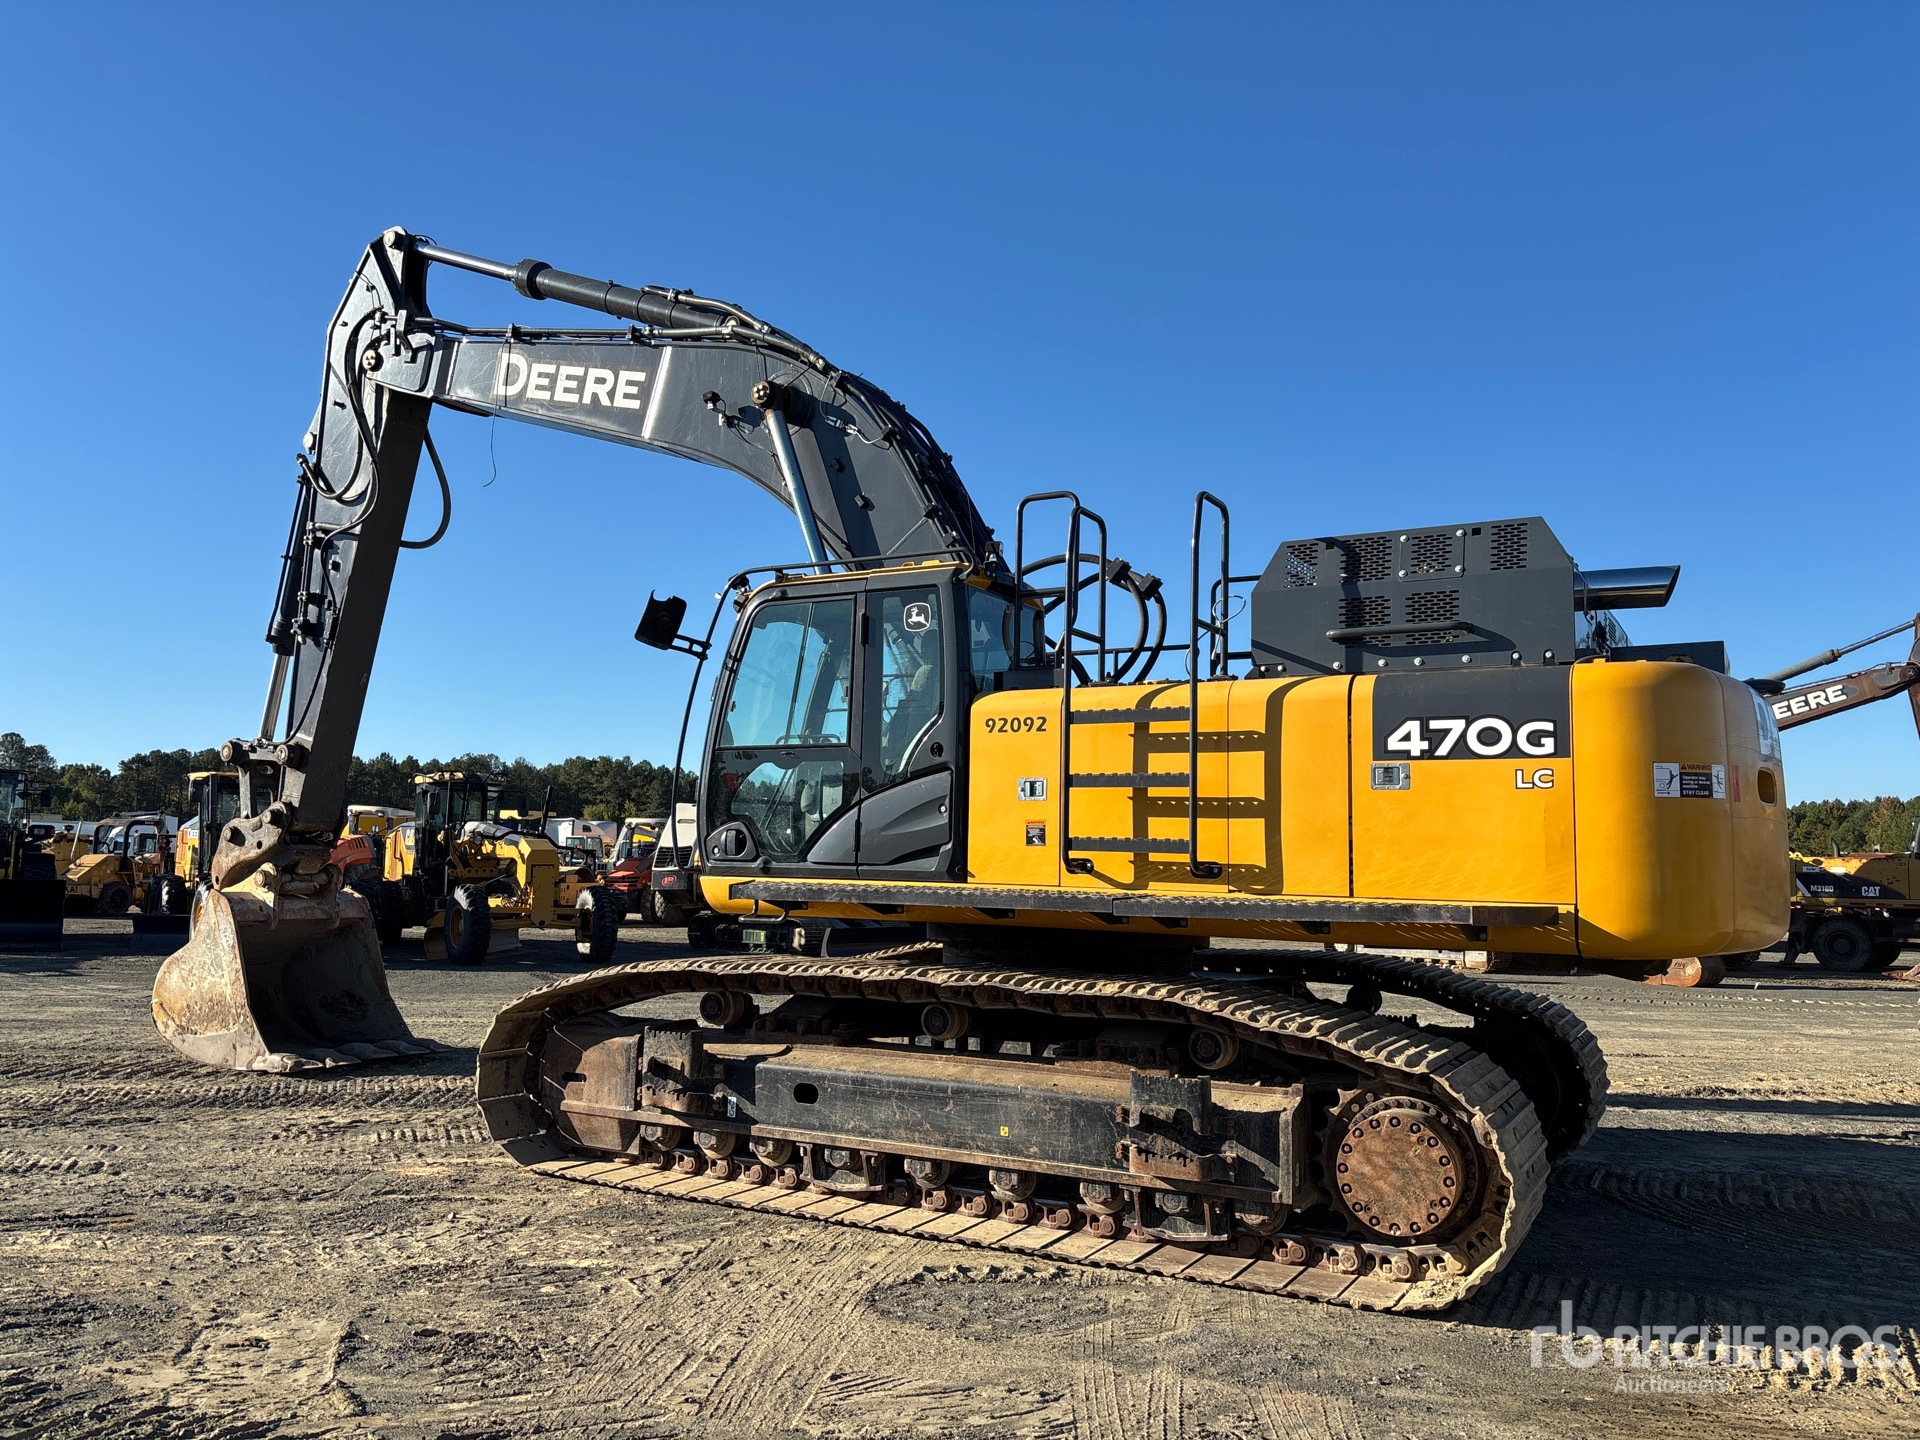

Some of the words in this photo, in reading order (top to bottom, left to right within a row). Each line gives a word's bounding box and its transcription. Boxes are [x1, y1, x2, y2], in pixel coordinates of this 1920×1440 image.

[493, 352, 647, 410] DEERE
[1771, 684, 1848, 720] EERE
[985, 716, 1048, 733] 92092
[1385, 715, 1557, 758] 470G
[1515, 768, 1554, 789] LC
[1810, 884, 1834, 892] M318D
[1861, 886, 1881, 897] CAT
